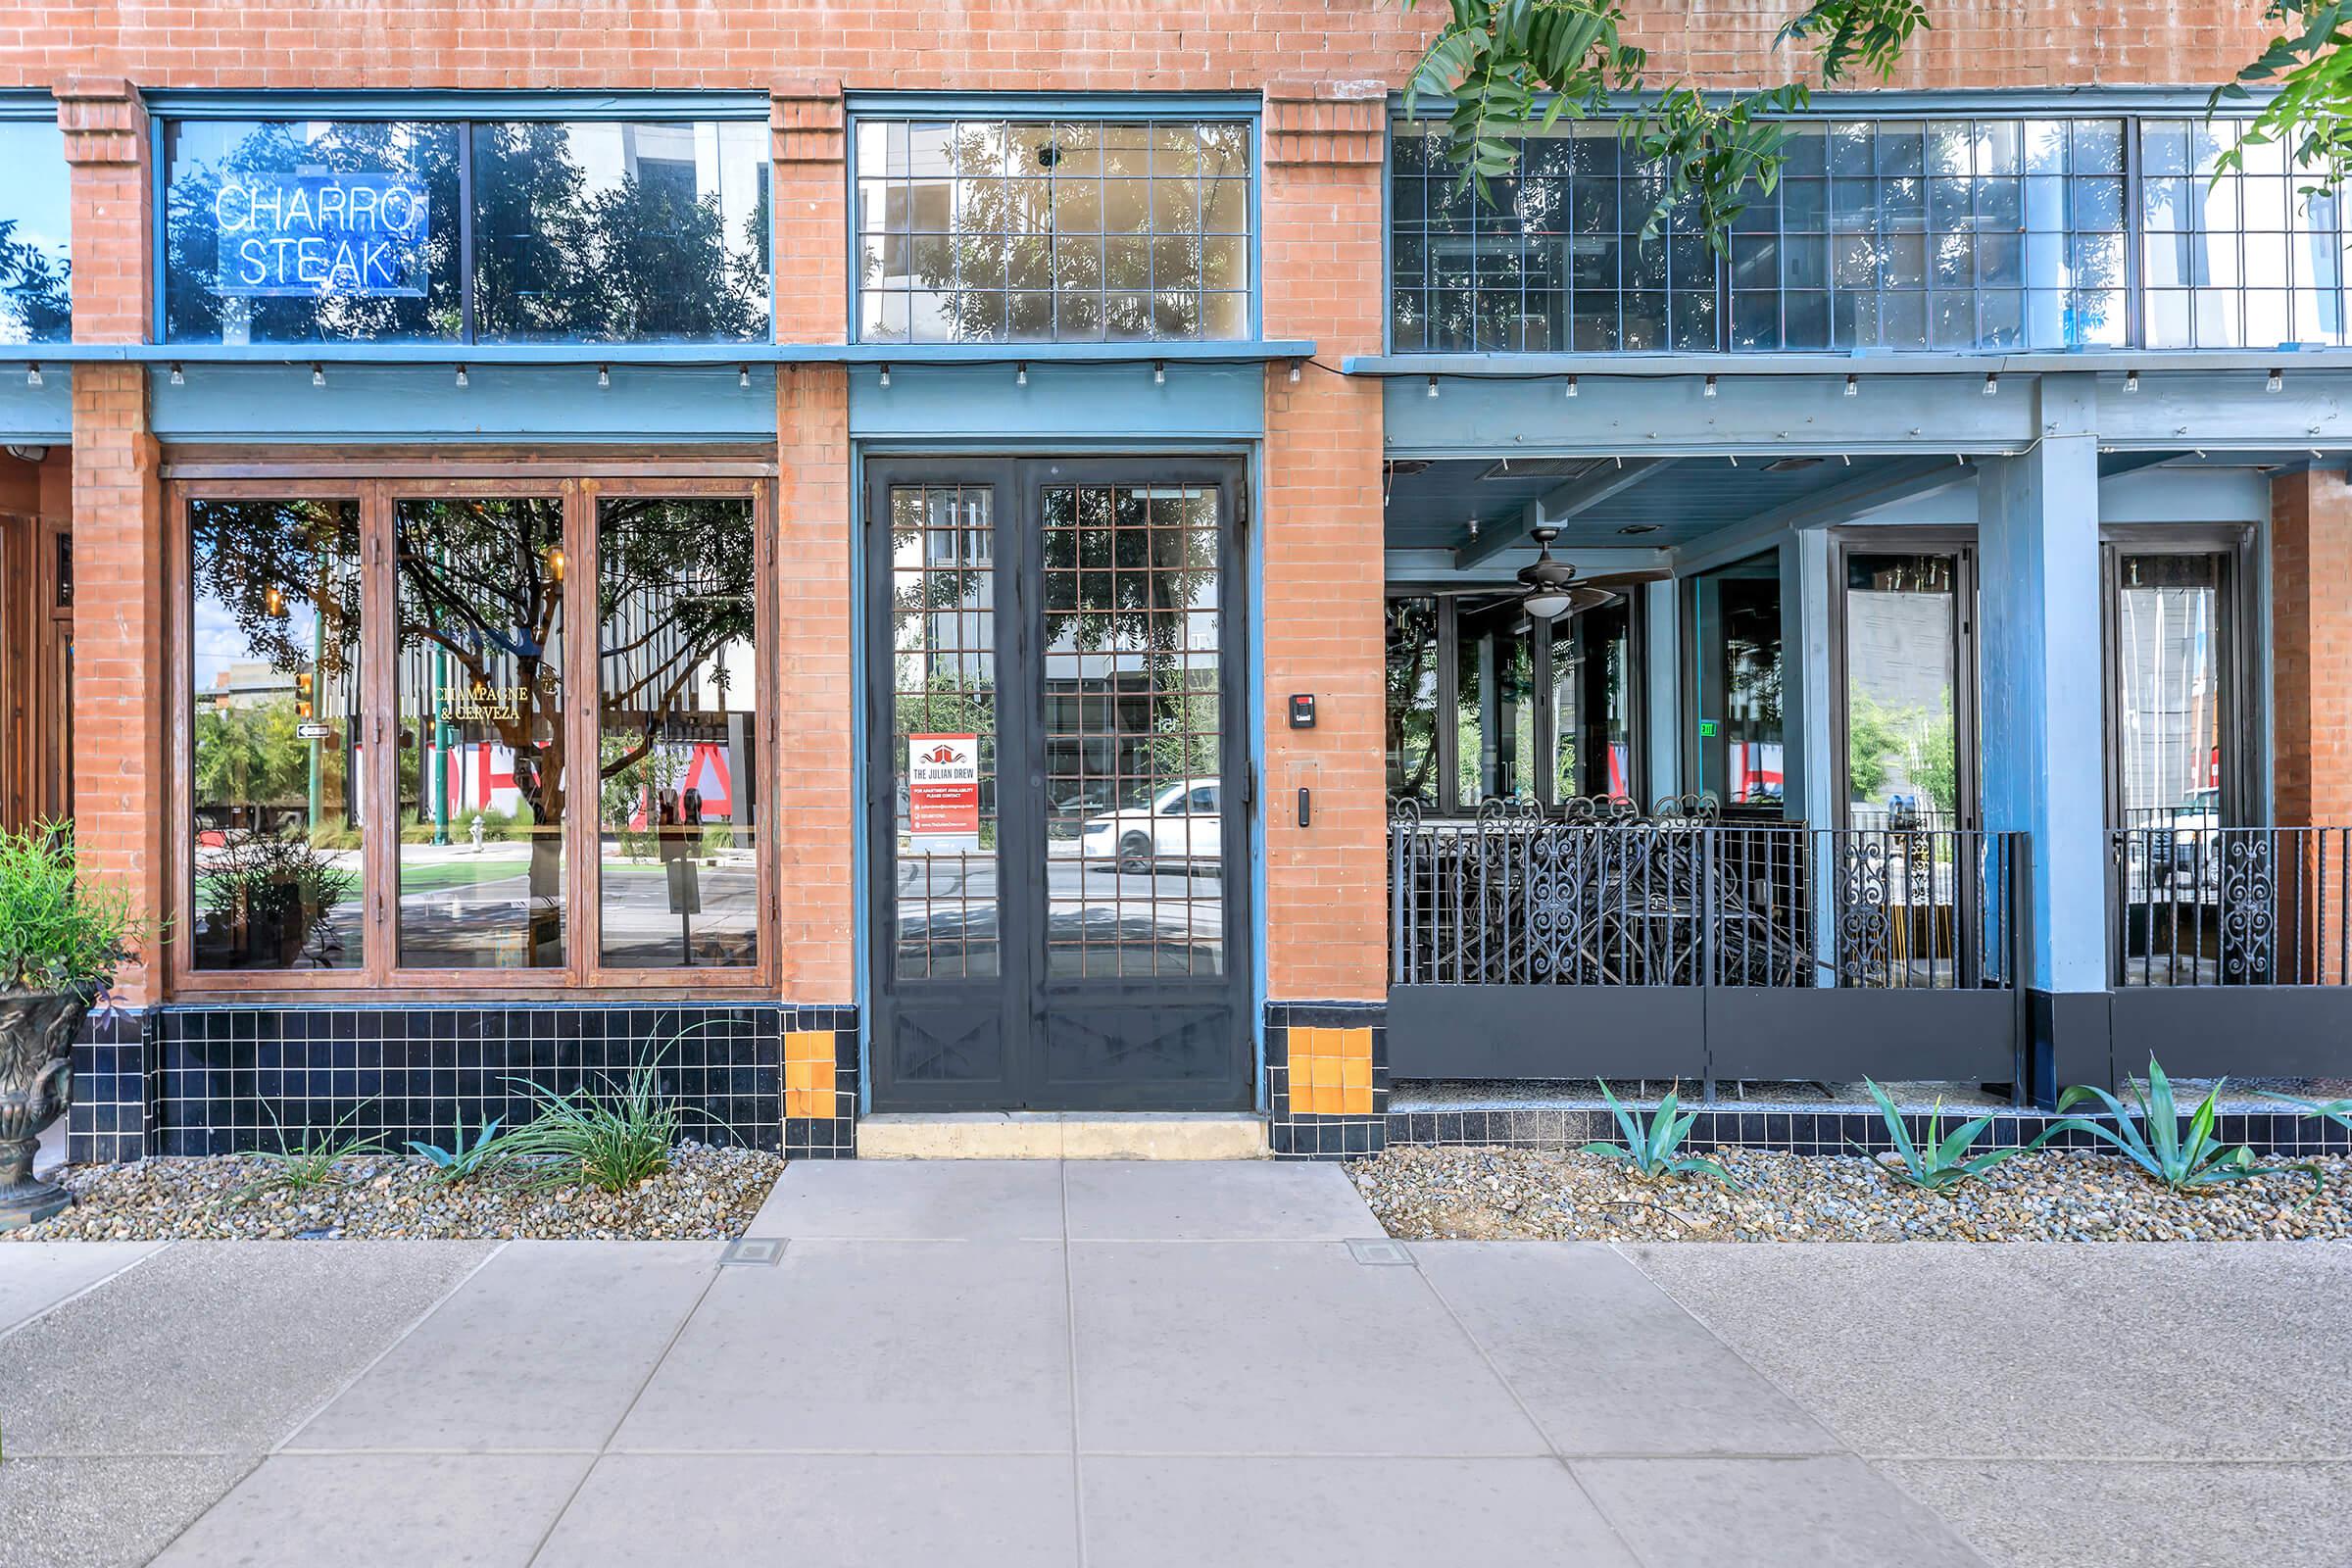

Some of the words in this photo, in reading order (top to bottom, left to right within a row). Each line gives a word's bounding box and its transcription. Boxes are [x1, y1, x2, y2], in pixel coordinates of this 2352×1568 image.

[215, 183, 416, 232] CHARRO
[239, 236, 392, 288] STEAK
[434, 687, 528, 701] CHAMPAGNE
[441, 707, 452, 720] &
[455, 706, 521, 720] CERVEZA
[913, 768, 927, 780] THE
[928, 767, 953, 780] JULIAN
[954, 767, 974, 779] DREW
